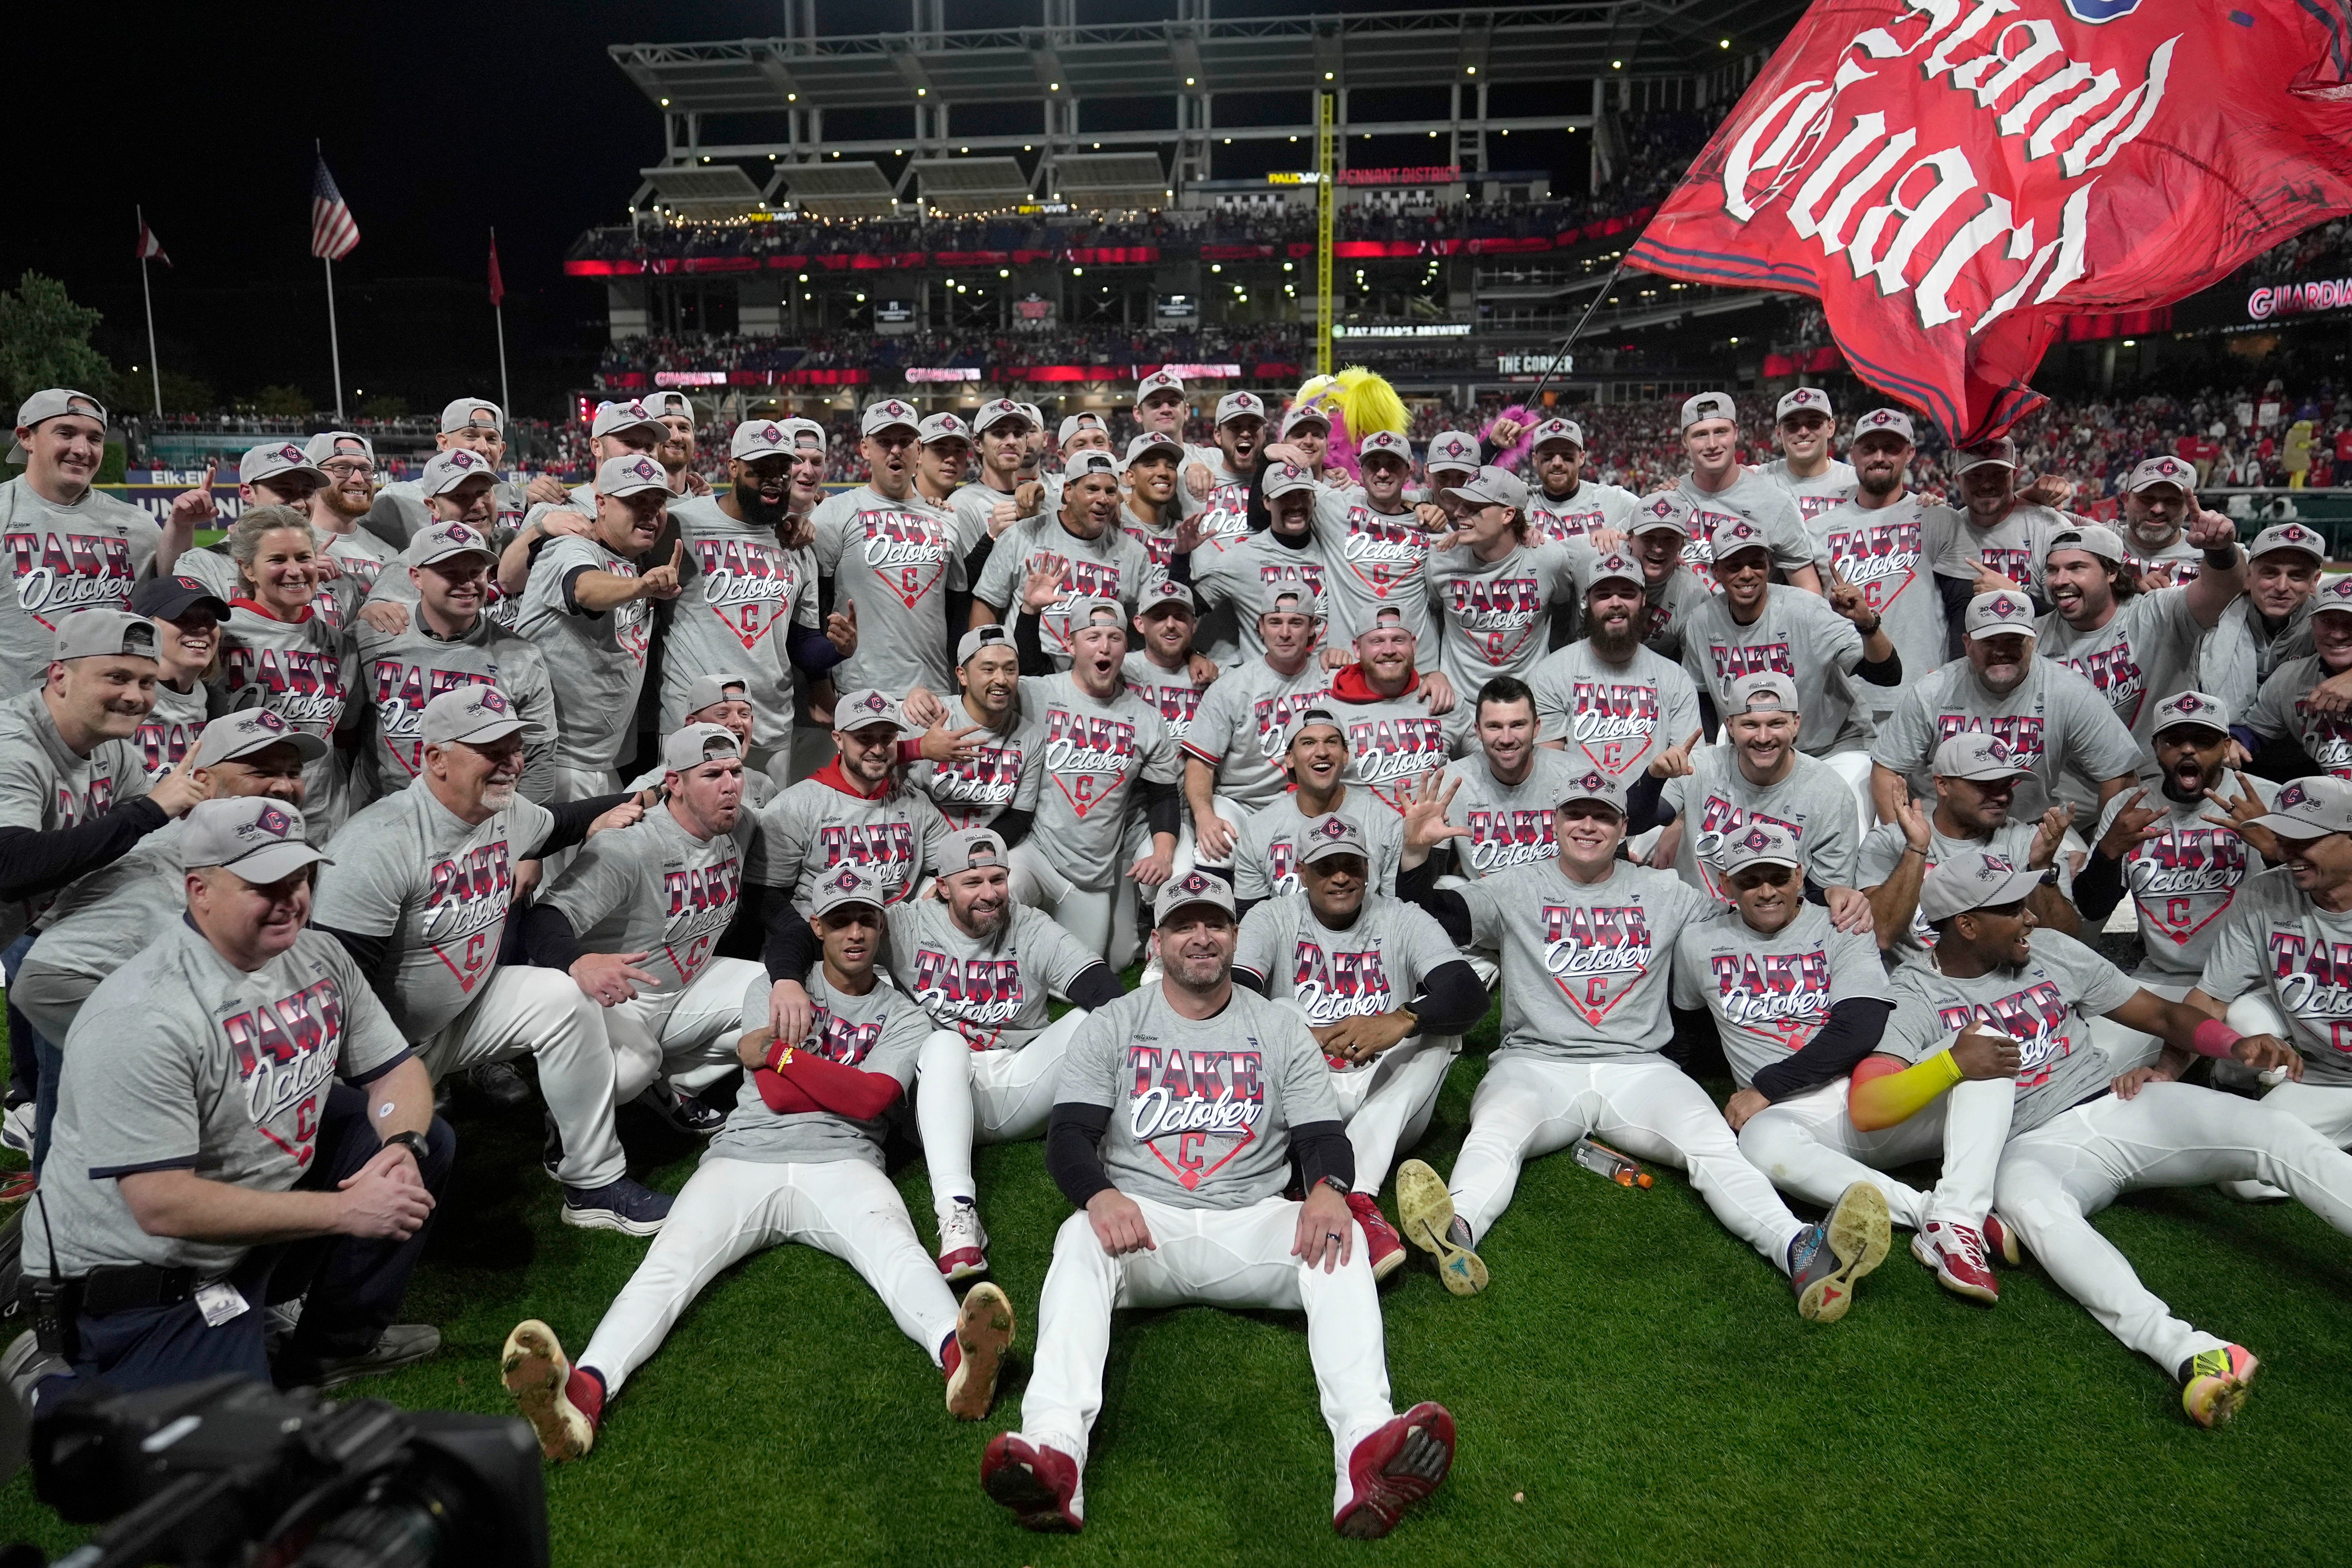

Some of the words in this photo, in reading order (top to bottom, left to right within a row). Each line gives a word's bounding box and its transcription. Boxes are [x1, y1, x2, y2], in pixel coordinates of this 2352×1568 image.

[1338, 168, 1399, 185] PENNANT
[1401, 166, 1461, 183] DISTRICT
[1346, 325, 1369, 337] FAT
[1416, 324, 1472, 336] BREWERY
[1498, 355, 1522, 374] THE
[891, 404, 899, 414] C
[1003, 401, 1012, 411] C
[1240, 396, 1248, 405] C
[1798, 392, 1806, 403] C
[635, 406, 644, 417] C
[946, 418, 954, 428] C
[1877, 413, 1886, 424] C
[767, 428, 776, 440] C
[1381, 436, 1388, 445] C
[288, 448, 299, 459] C
[456, 454, 468, 465] C
[1451, 443, 1459, 454] C
[641, 464, 650, 475] C
[1287, 466, 1296, 476] C
[2163, 463, 2173, 472] C
[1657, 503, 1666, 514] C
[453, 527, 464, 539] C
[858, 510, 947, 552] TAKE
[1346, 506, 1430, 550] TAKE
[1739, 526, 1747, 537] C
[2289, 529, 2299, 539] C
[864, 533, 949, 567] October
[1344, 531, 1430, 562] October
[1828, 522, 1922, 564] TAKE
[4, 533, 135, 580] TAKE
[695, 540, 793, 583] TAKE
[1611, 558, 1619, 569] C
[177, 577, 200, 590] C
[703, 567, 794, 604] October
[902, 567, 918, 592] C
[1373, 564, 1389, 584] C
[17, 565, 135, 611] October
[1451, 578, 1541, 613] TAKE
[1864, 582, 1882, 607] C
[2341, 582, 2352, 593] C
[741, 604, 758, 632] C
[1459, 602, 1537, 630] October
[1998, 601, 2008, 612] C
[1487, 633, 1503, 656] C
[219, 646, 347, 701] TAKE
[1710, 642, 1794, 679] TAKE
[227, 682, 346, 725] October
[489, 694, 502, 708] C
[872, 697, 882, 708] C
[1573, 683, 1659, 721] TAKE
[2183, 698, 2194, 709] C
[264, 714, 280, 727] C
[1573, 708, 1657, 742] October
[1046, 710, 1135, 759] TAKE
[1350, 718, 1444, 759] TAKE
[1045, 737, 1134, 772] October
[1356, 740, 1443, 782] October
[1604, 742, 1621, 767] C
[1995, 744, 2004, 756] C
[931, 770, 1016, 802] October
[1075, 775, 1093, 802] C
[1588, 775, 1598, 788] C
[2285, 789, 2300, 803] C
[267, 811, 284, 830] C
[1329, 822, 1339, 834] C
[821, 822, 914, 870] TAKE
[1472, 834, 1561, 870] October
[1752, 834, 1762, 847] C
[426, 840, 510, 910] TAKE
[1987, 856, 1998, 868] C
[665, 858, 741, 917] TAKE
[843, 875, 853, 887] C
[1190, 876, 1200, 890] C
[2129, 857, 2243, 894] October
[2167, 898, 2192, 928] C
[1542, 905, 1651, 949] TAKE
[465, 933, 485, 971] C
[686, 935, 709, 967] C
[1544, 934, 1651, 973] October
[913, 949, 1023, 1005] TAKE
[1293, 941, 1390, 998] TAKE
[1711, 949, 1830, 998] TAKE
[1294, 979, 1391, 1020] October
[1585, 976, 1607, 1007] C
[1721, 979, 1830, 1027] October
[223, 977, 343, 1084] TAKE
[1127, 1045, 1265, 1105] TAKE
[296, 1095, 316, 1142] C
[1130, 1085, 1263, 1139] October
[1178, 1131, 1206, 1170] C
